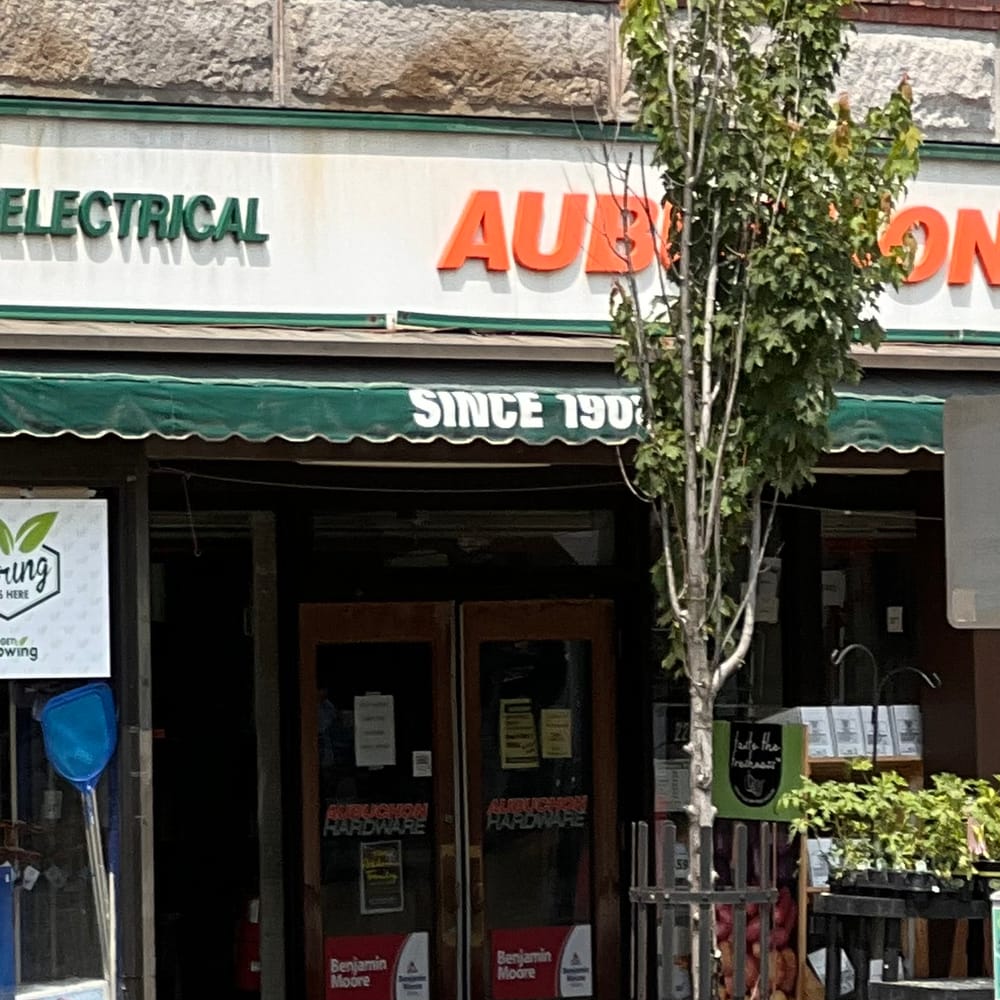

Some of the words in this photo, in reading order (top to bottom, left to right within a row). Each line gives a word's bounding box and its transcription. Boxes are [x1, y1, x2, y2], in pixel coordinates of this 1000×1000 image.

[0, 187, 269, 243] ELECTRICAL
[409, 389, 545, 429] SINCE
[6, 589, 29, 599] HERE
[330, 955, 387, 975] Benjamin
[497, 947, 552, 966] Benjamin
[330, 974, 370, 988] Moore
[497, 966, 536, 980] Moore
